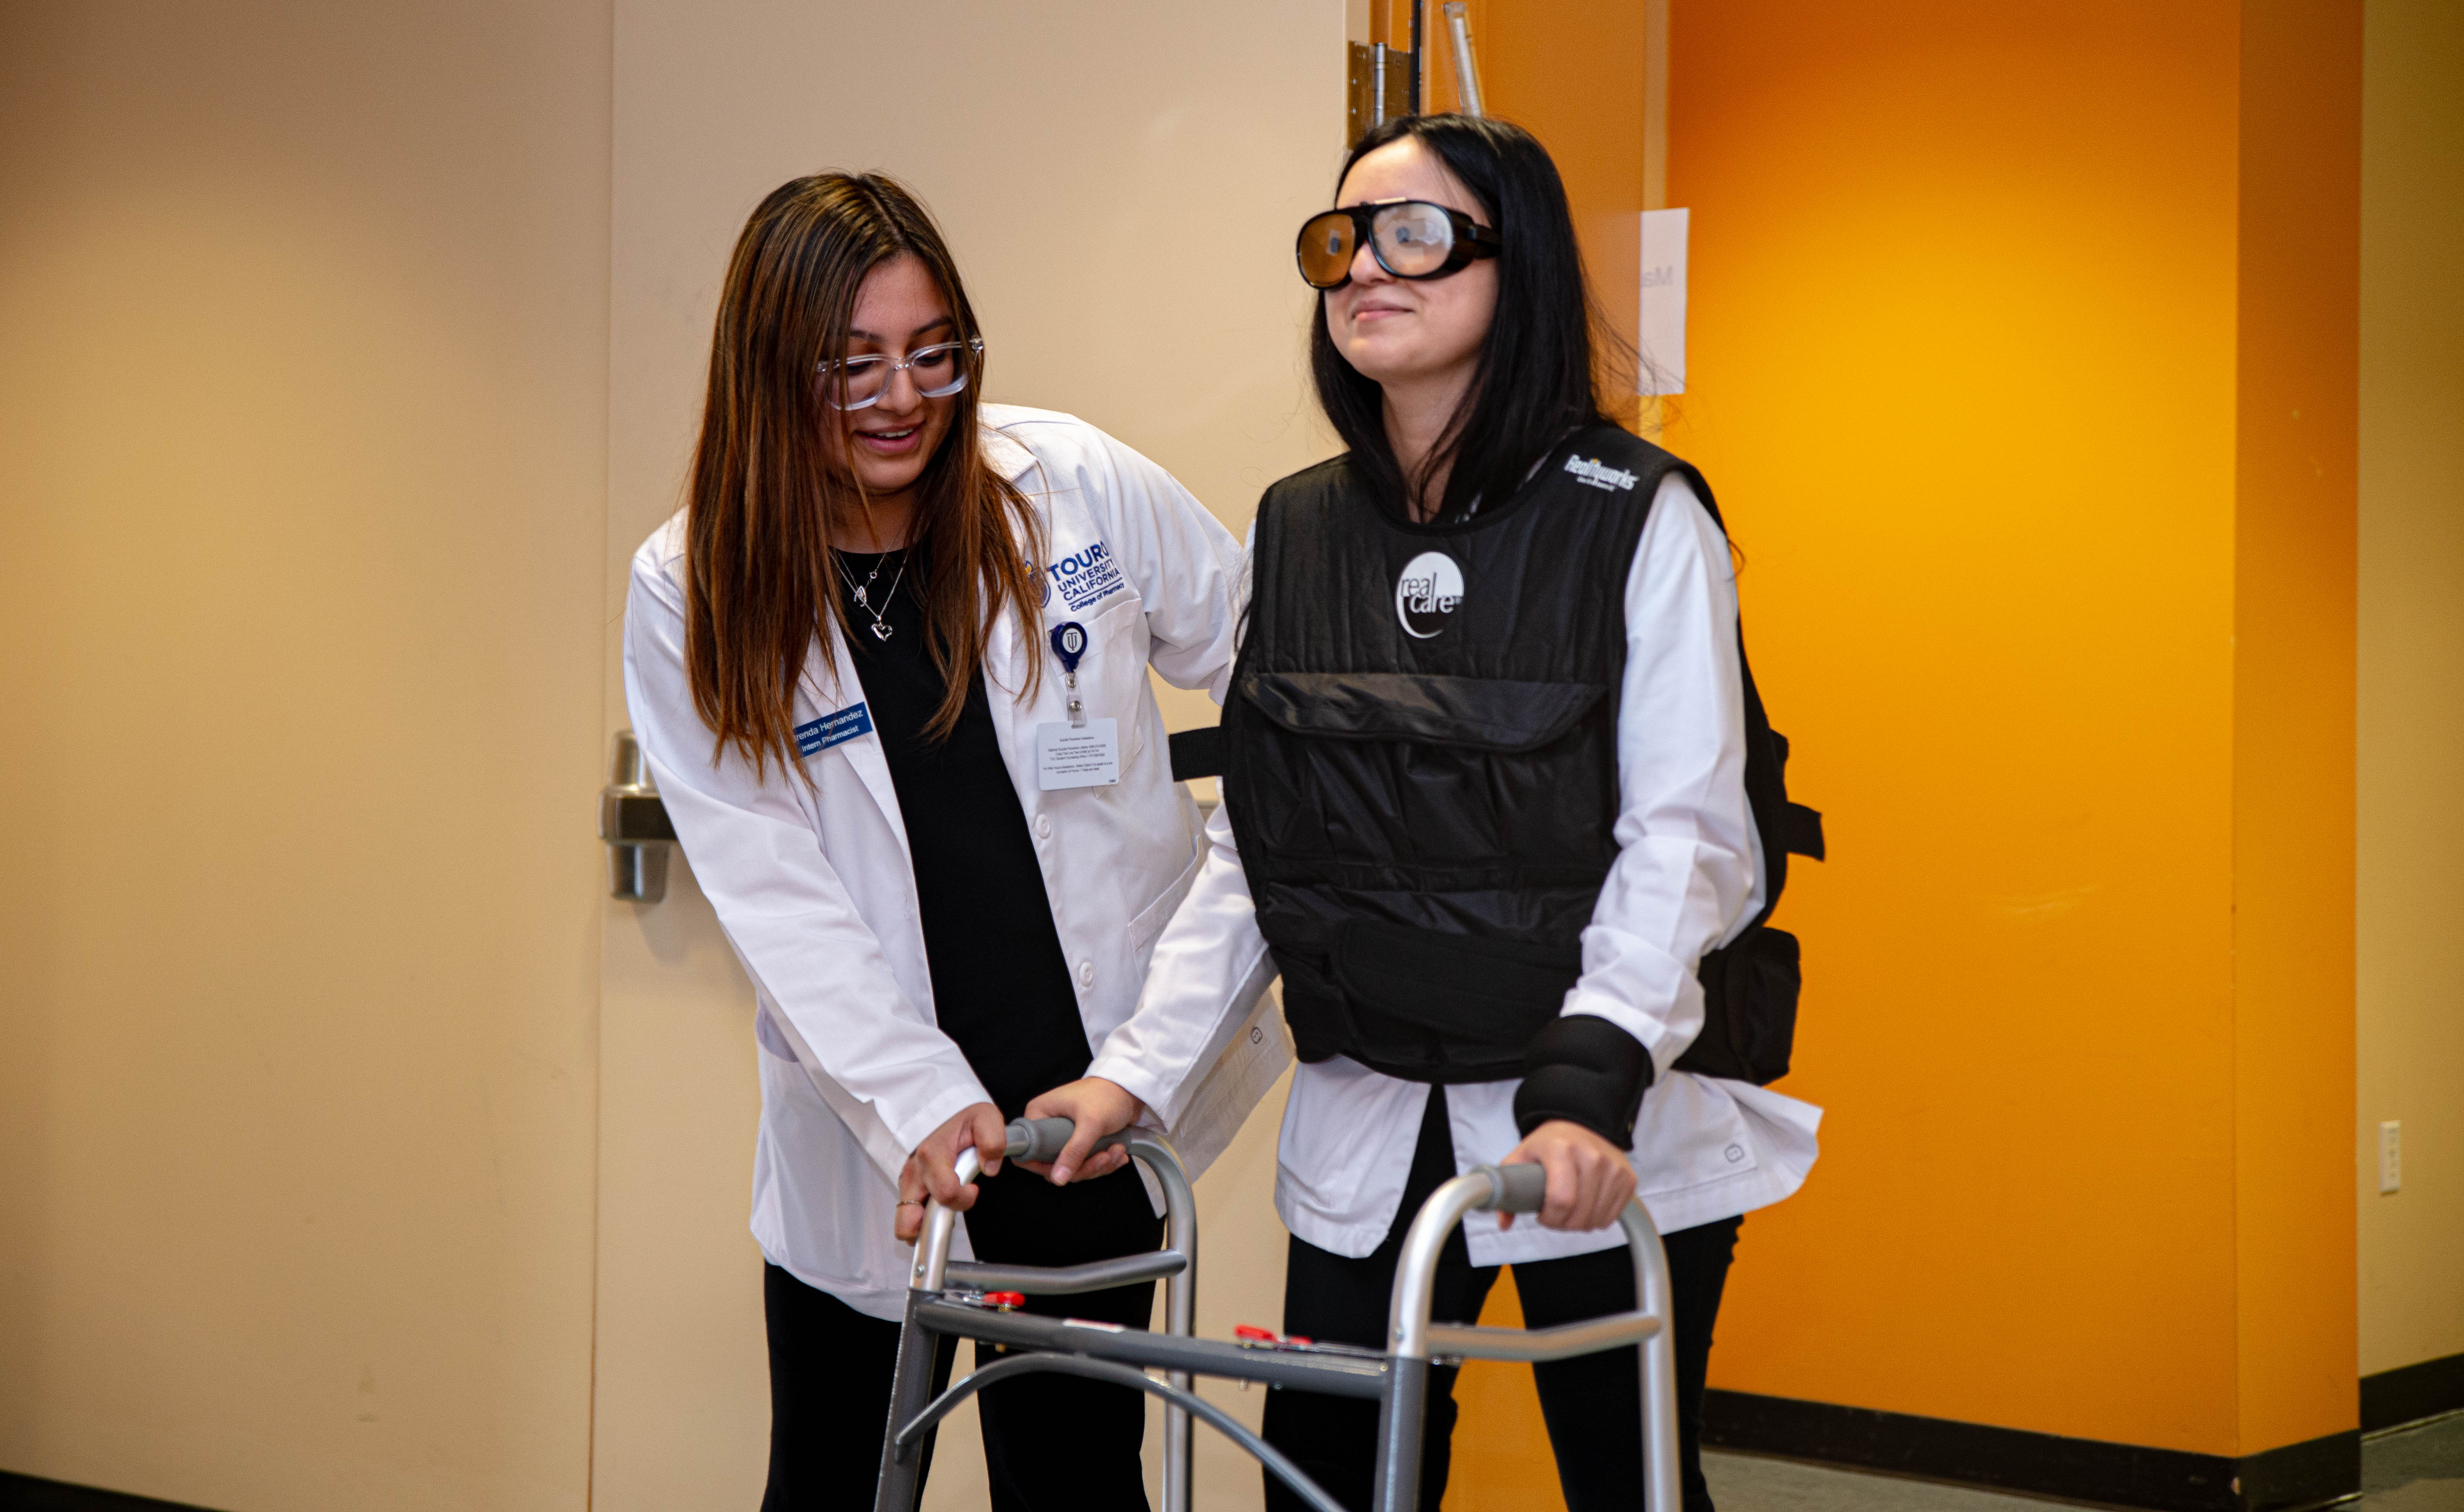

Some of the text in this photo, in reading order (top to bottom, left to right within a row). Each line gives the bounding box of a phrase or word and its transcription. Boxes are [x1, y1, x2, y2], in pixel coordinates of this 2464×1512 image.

[1057, 558, 1114, 592] UNIVERSITY
[1063, 568, 1120, 601] CALIFORNIA
[1401, 572, 1437, 598] real
[1070, 597, 1097, 612] College
[1103, 582, 1124, 597] Pharmacy
[820, 710, 863, 732] Hernandez
[802, 725, 859, 752] Intern Pharmacist
